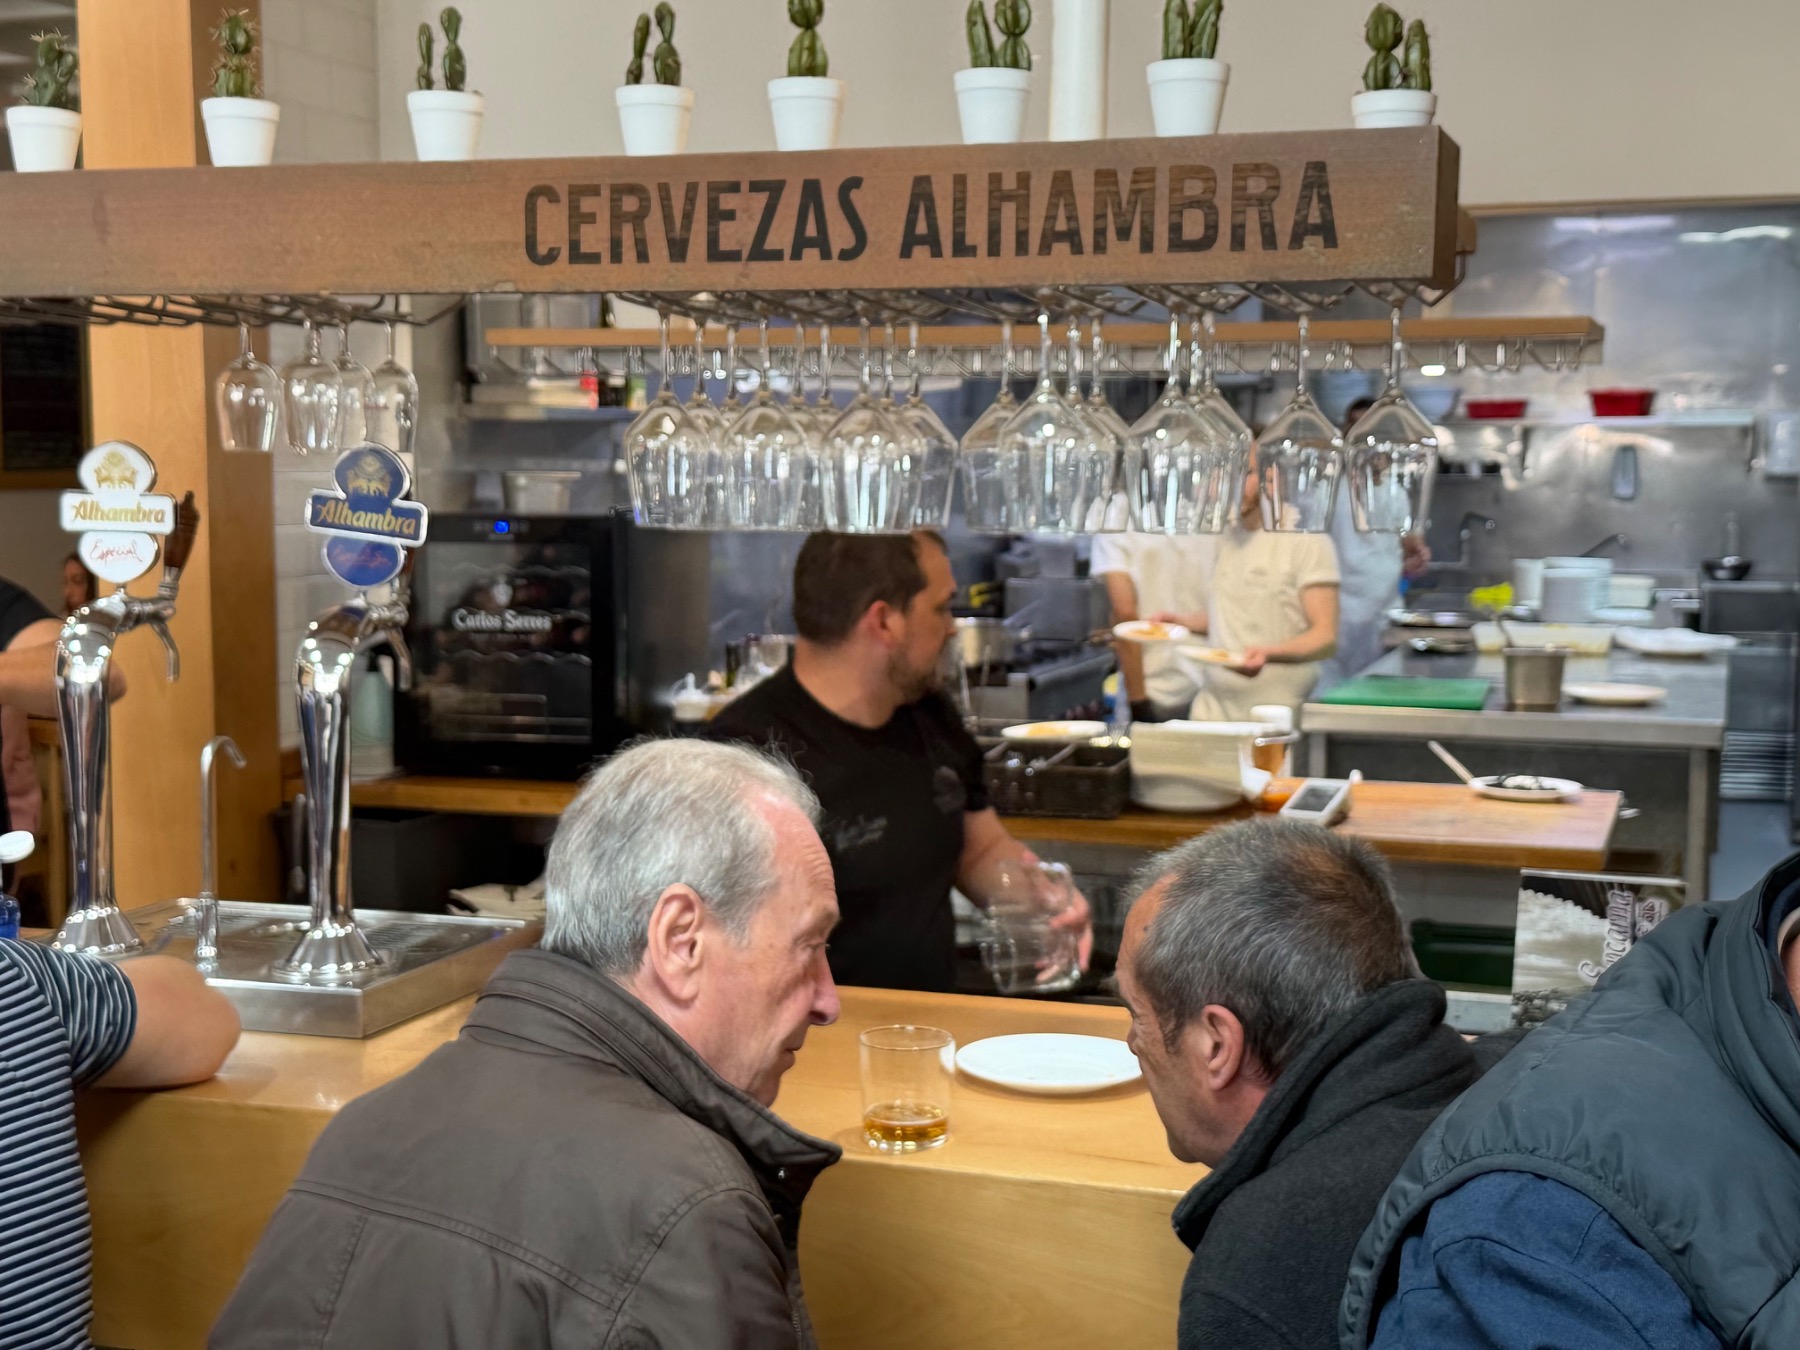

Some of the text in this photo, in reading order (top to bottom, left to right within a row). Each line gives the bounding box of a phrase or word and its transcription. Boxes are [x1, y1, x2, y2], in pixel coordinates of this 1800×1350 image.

[524, 161, 1339, 266] CERVEZAS ALHAMBRA
[72, 500, 166, 524] Alhambra
[316, 500, 416, 535] Alhambra
[453, 608, 502, 632] Carlos
